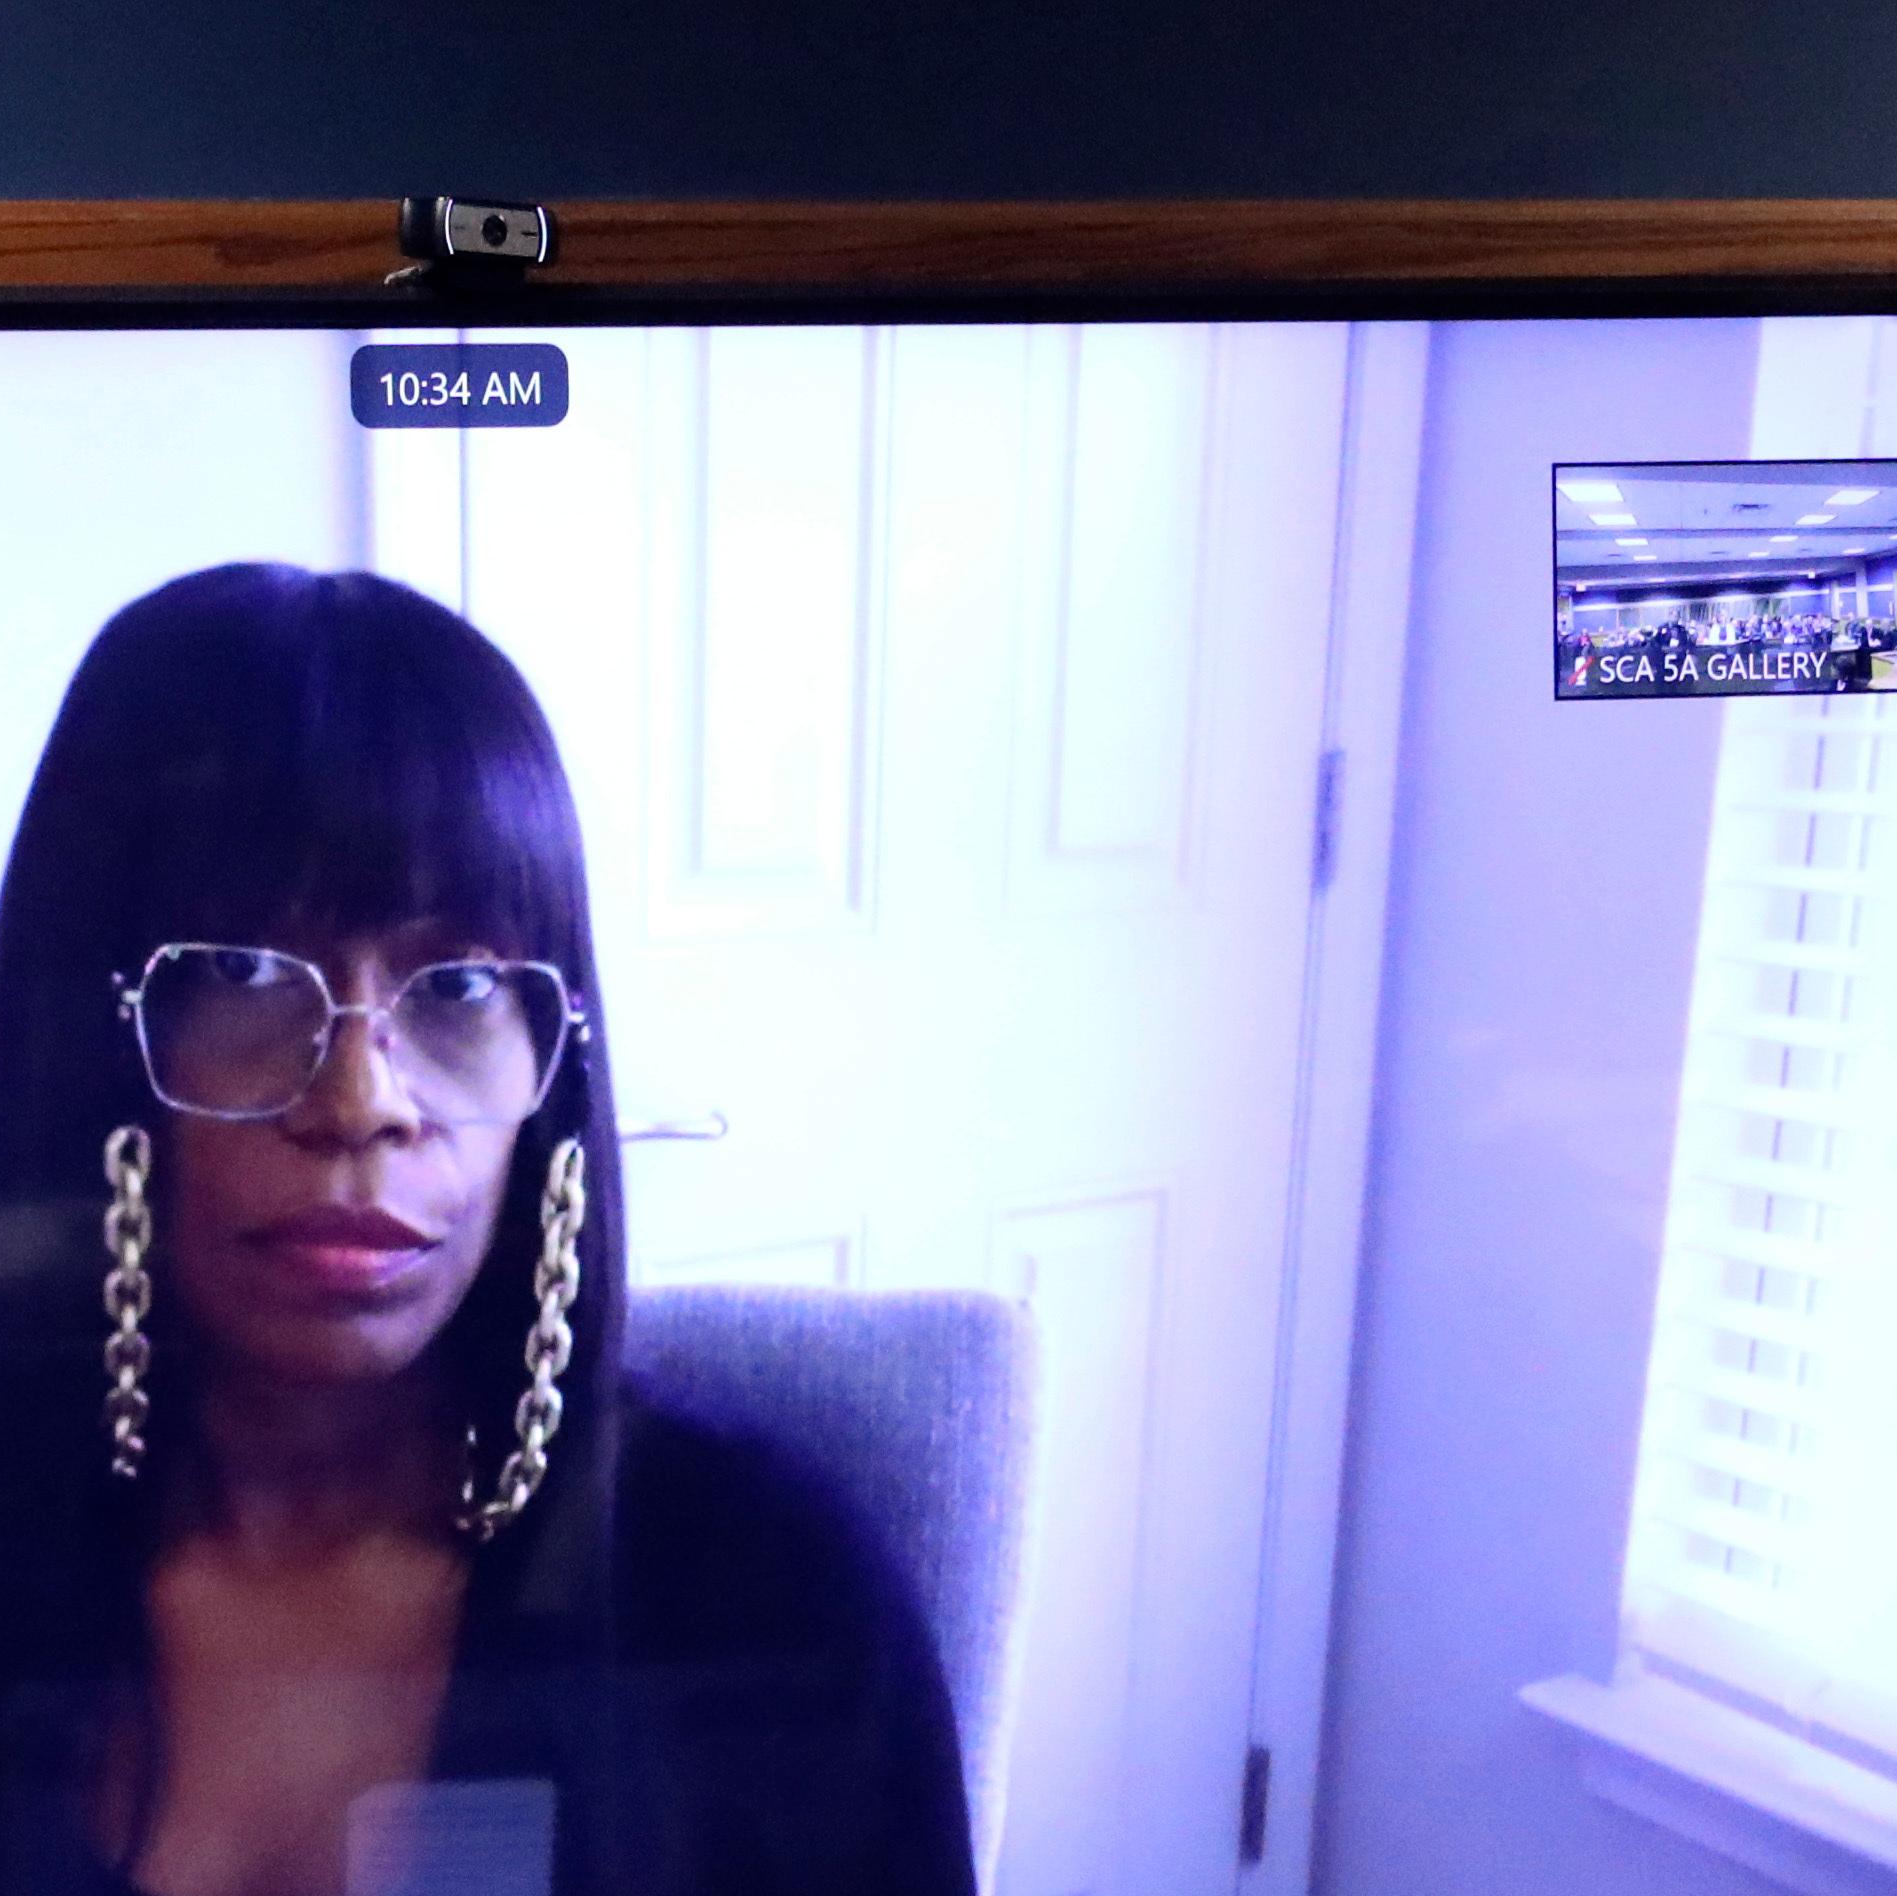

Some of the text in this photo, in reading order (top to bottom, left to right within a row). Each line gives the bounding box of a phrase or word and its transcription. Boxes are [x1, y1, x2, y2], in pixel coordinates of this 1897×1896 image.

[380, 371, 541, 406] 10:34 AM
[1599, 651, 1828, 684] SCA 5A GALLERY
